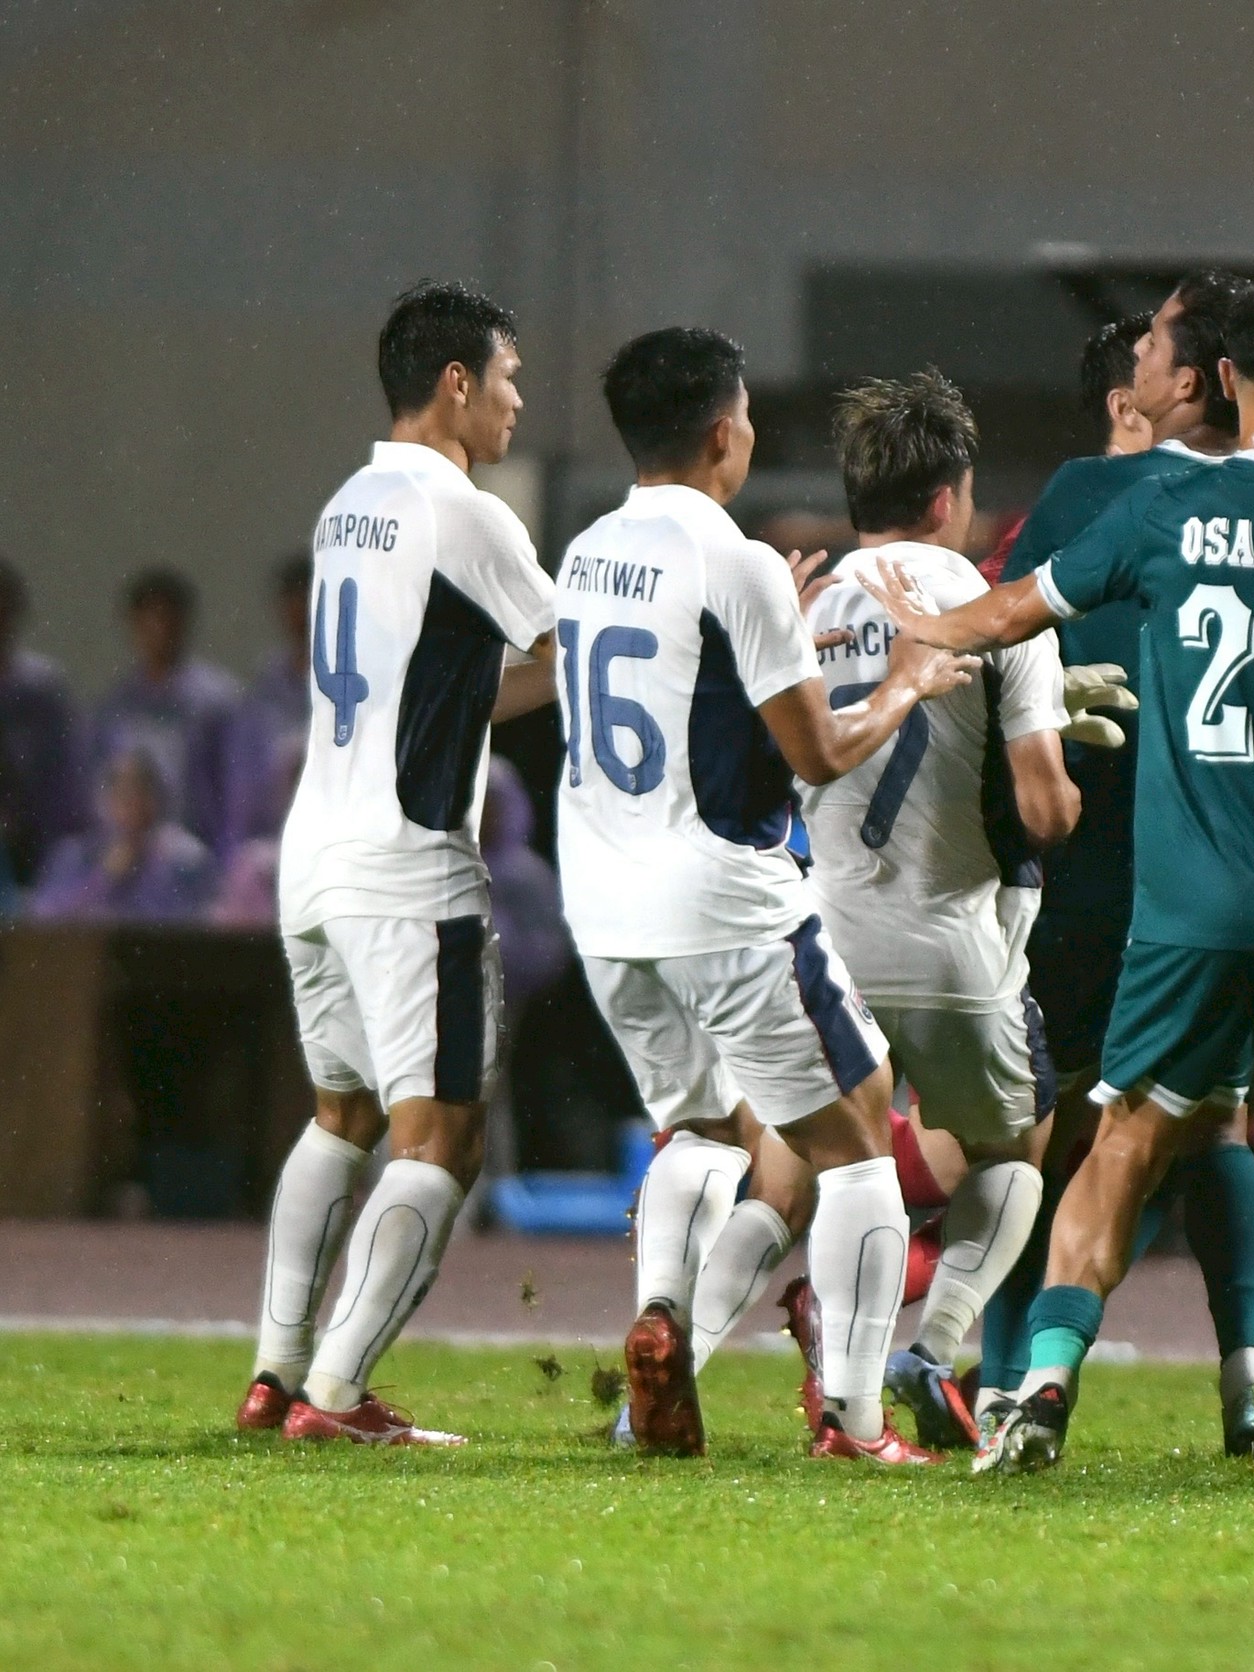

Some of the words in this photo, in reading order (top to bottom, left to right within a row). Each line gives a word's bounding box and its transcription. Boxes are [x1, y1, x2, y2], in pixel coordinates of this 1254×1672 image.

[313, 577, 370, 747] 4
[567, 555, 663, 603] PHITIWAT
[558, 618, 667, 796] 16
[830, 681, 929, 849] 7
